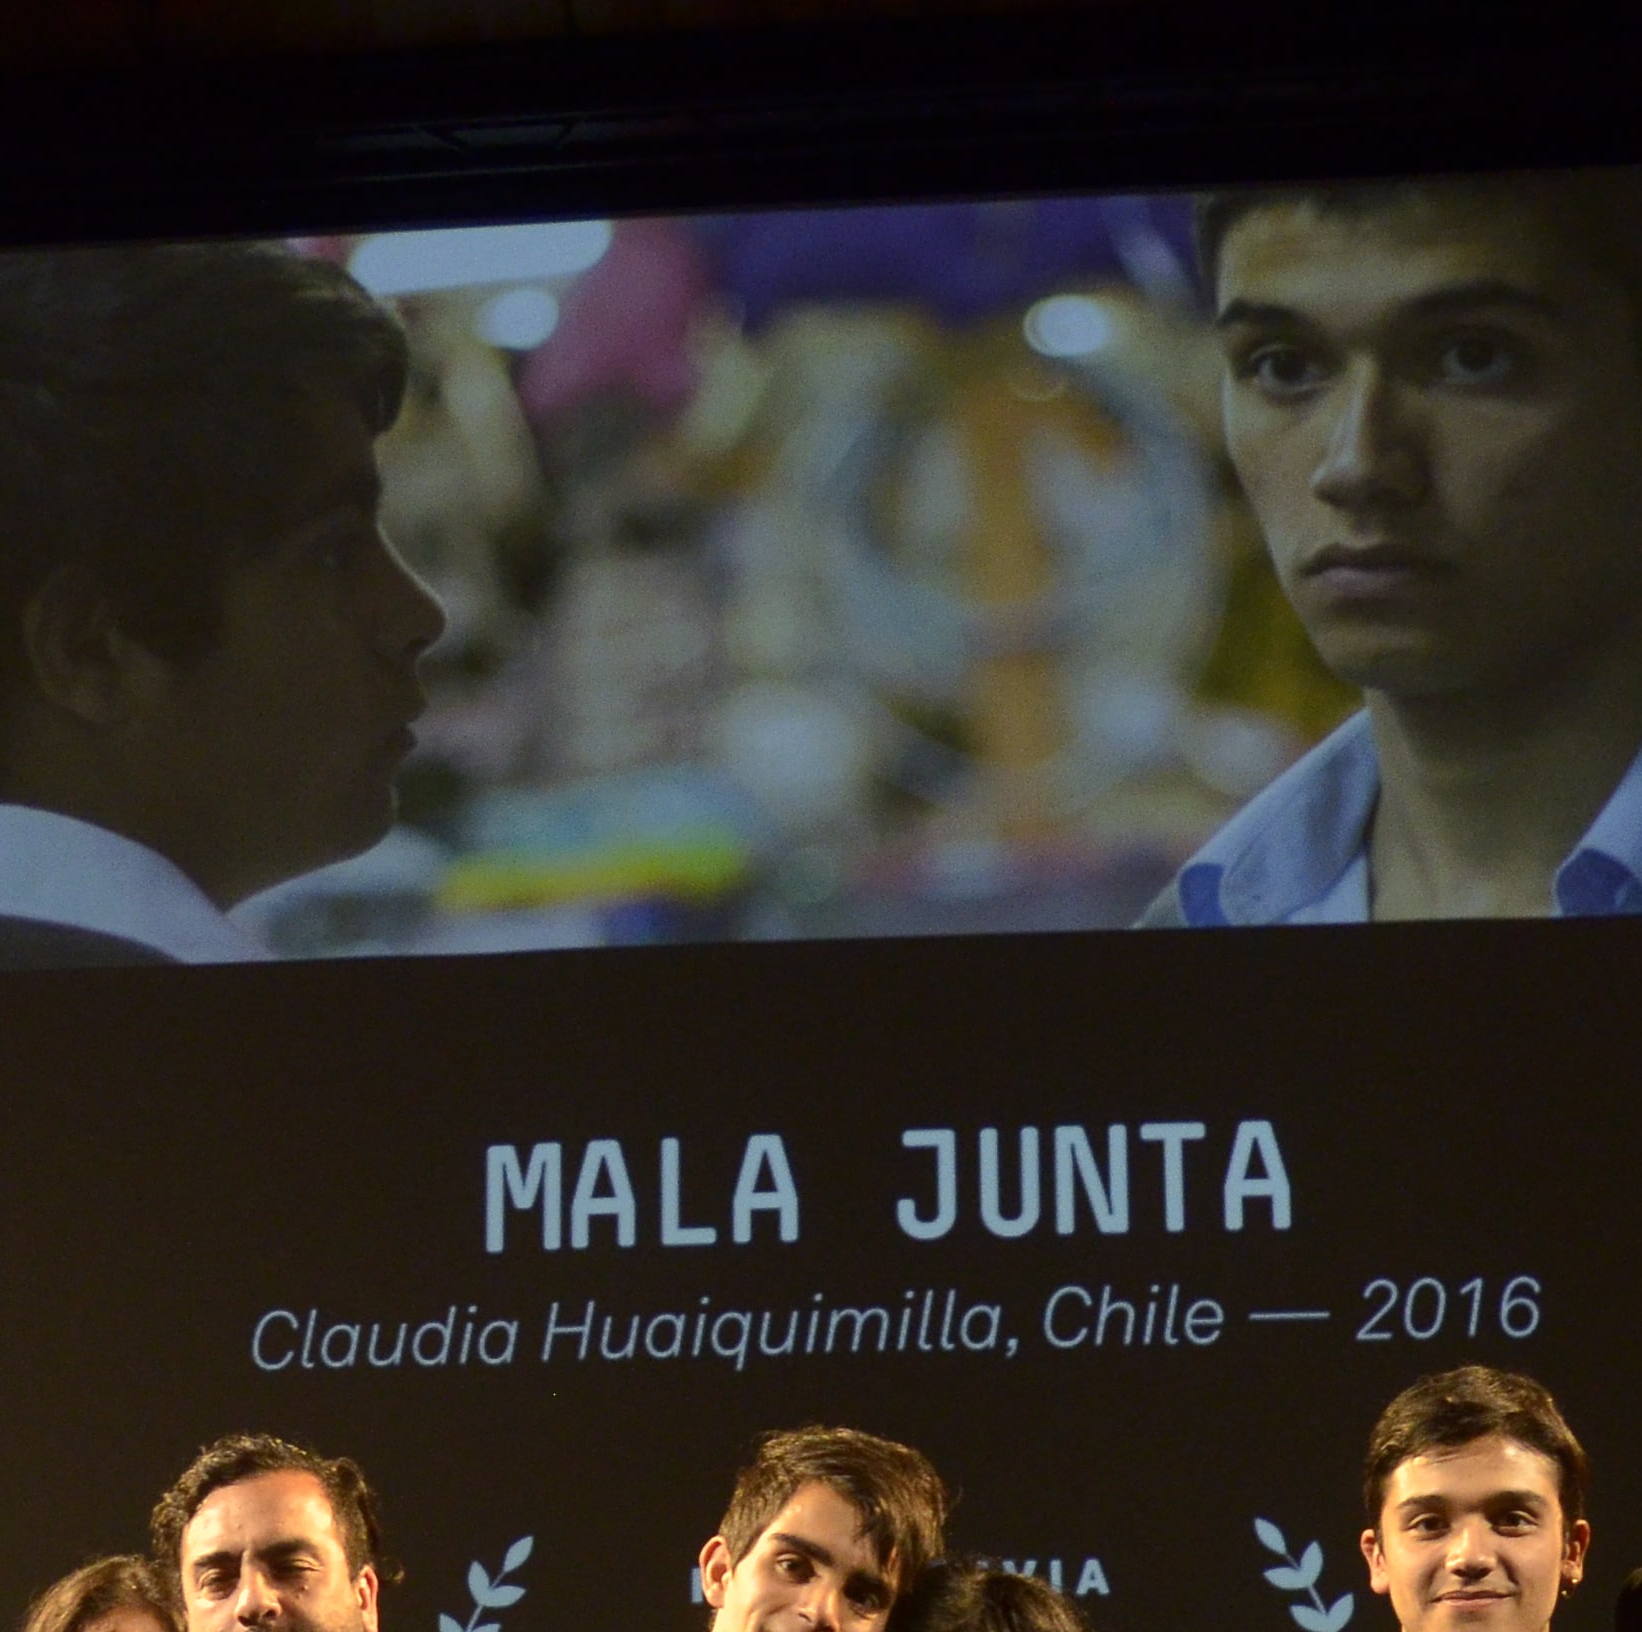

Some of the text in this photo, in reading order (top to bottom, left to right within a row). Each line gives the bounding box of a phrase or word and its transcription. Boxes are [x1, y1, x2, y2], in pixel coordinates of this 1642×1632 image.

[484, 1119, 1293, 1254] MALA JUNTA
[251, 1305, 520, 1372] Claudia
[541, 1289, 1019, 1372] Huaiquimilla,
[1043, 1283, 1225, 1348] Chile
[1356, 1275, 1541, 1341] 2016
